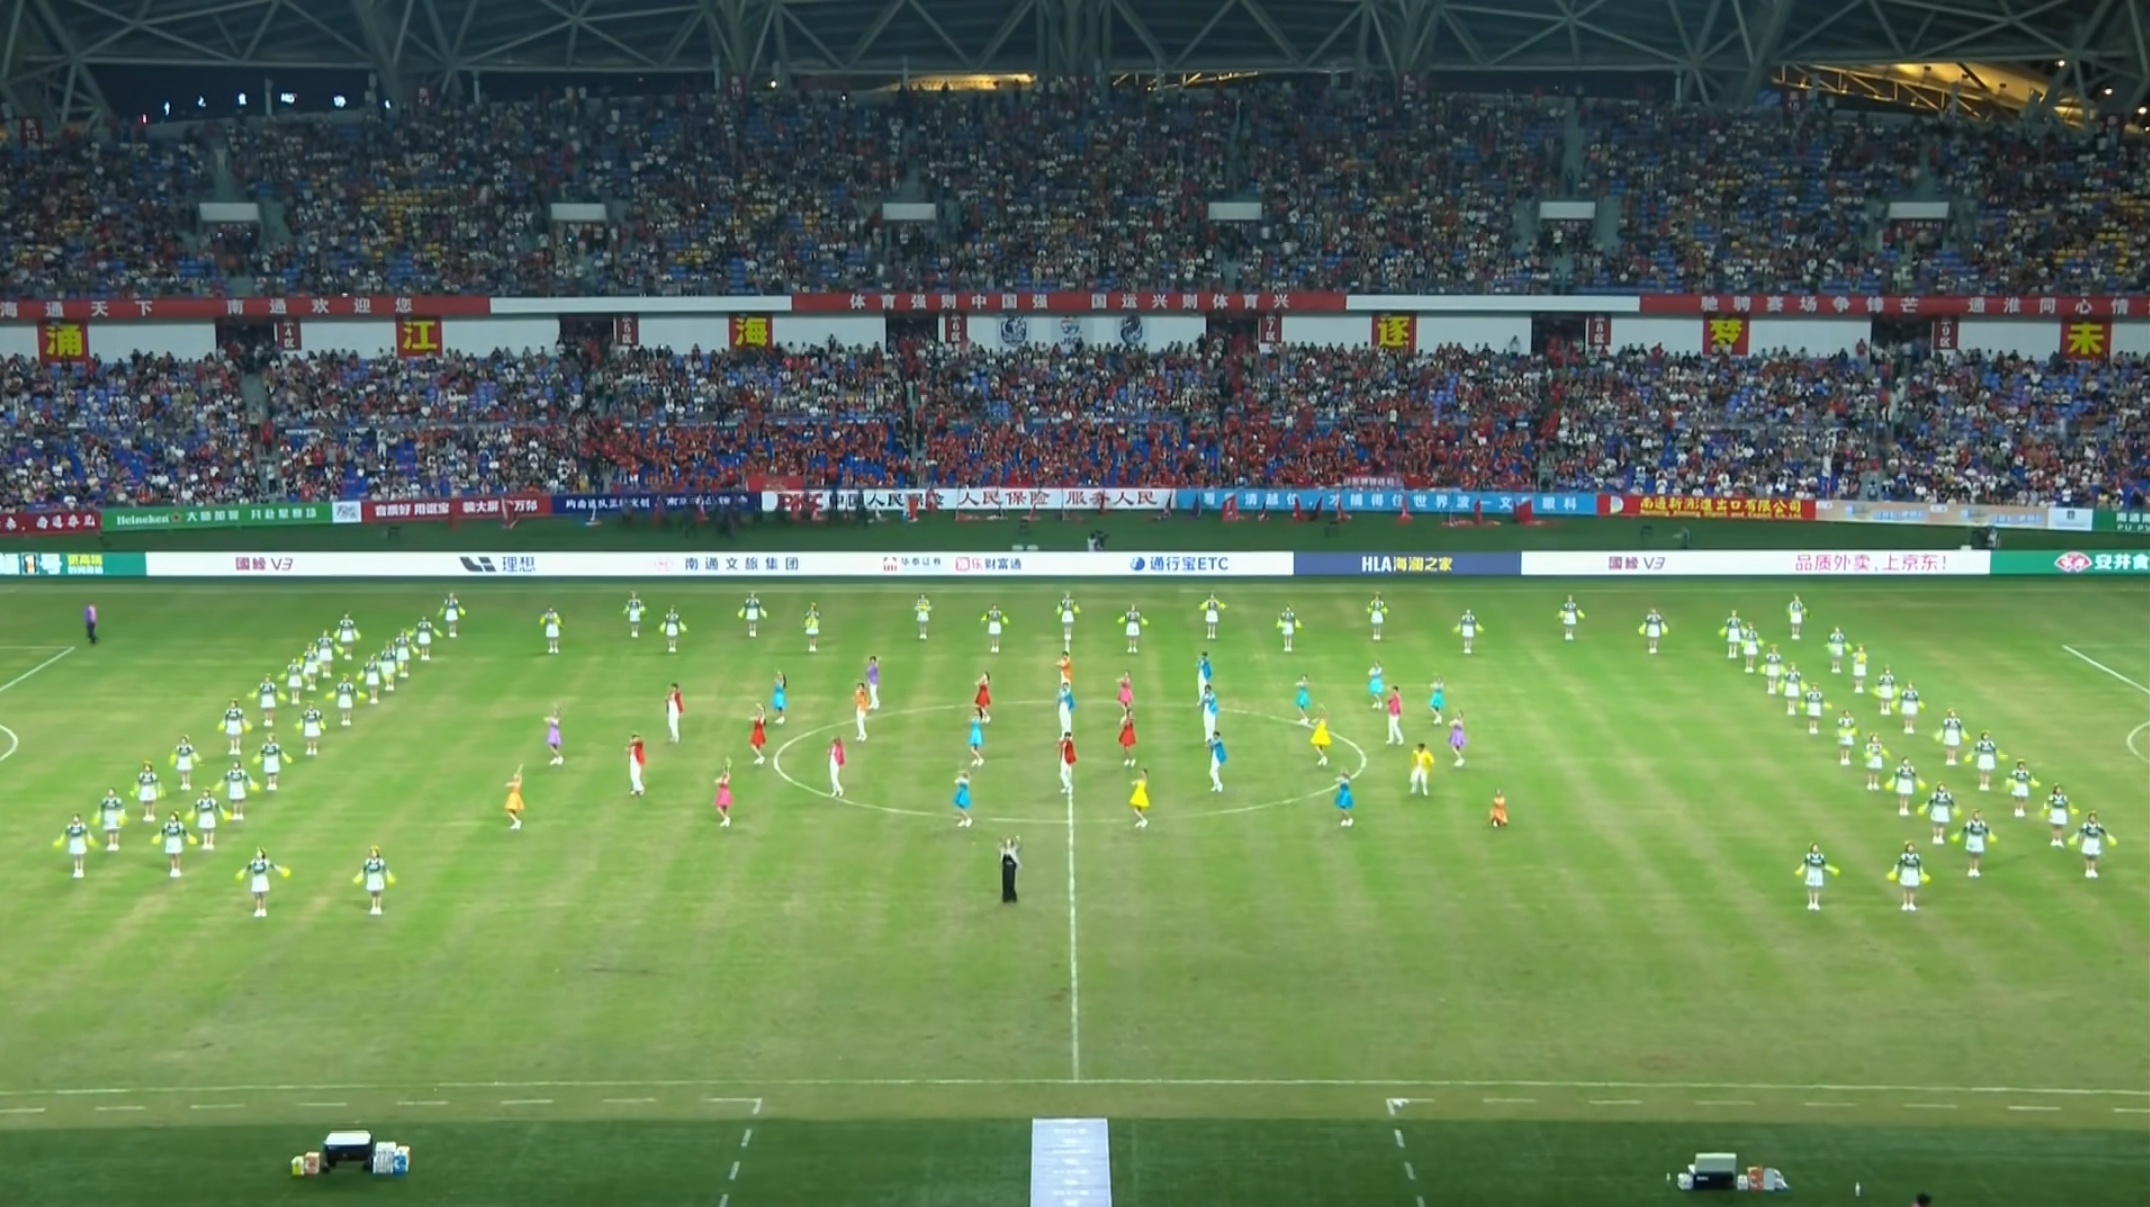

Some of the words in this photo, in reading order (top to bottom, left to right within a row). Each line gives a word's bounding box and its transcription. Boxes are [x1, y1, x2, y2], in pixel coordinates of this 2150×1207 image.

[0, 300, 153, 318] 海通天下
[227, 298, 413, 315] 南通欢迎您
[850, 293, 1048, 310] 体育强则中国强
[1091, 293, 1289, 310] 国运兴则体育兴
[1702, 295, 1919, 314] 驰骋赛场争锋芒
[1968, 297, 2150, 315] 通淮同心情
[46, 322, 83, 357] 涌
[403, 320, 438, 350] 江
[735, 316, 768, 347] 海
[1378, 315, 1409, 348] 逐
[1710, 318, 1743, 346] 梦
[2067, 321, 2104, 355] 未
[961, 490, 1050, 506] 人民保险
[1066, 490, 1158, 506] 服务人民
[117, 513, 169, 526] Heineken
[270, 557, 294, 571] V3
[502, 556, 536, 572] 理想
[685, 556, 799, 571] 南通文旅集团
[1644, 557, 1666, 570] V3
